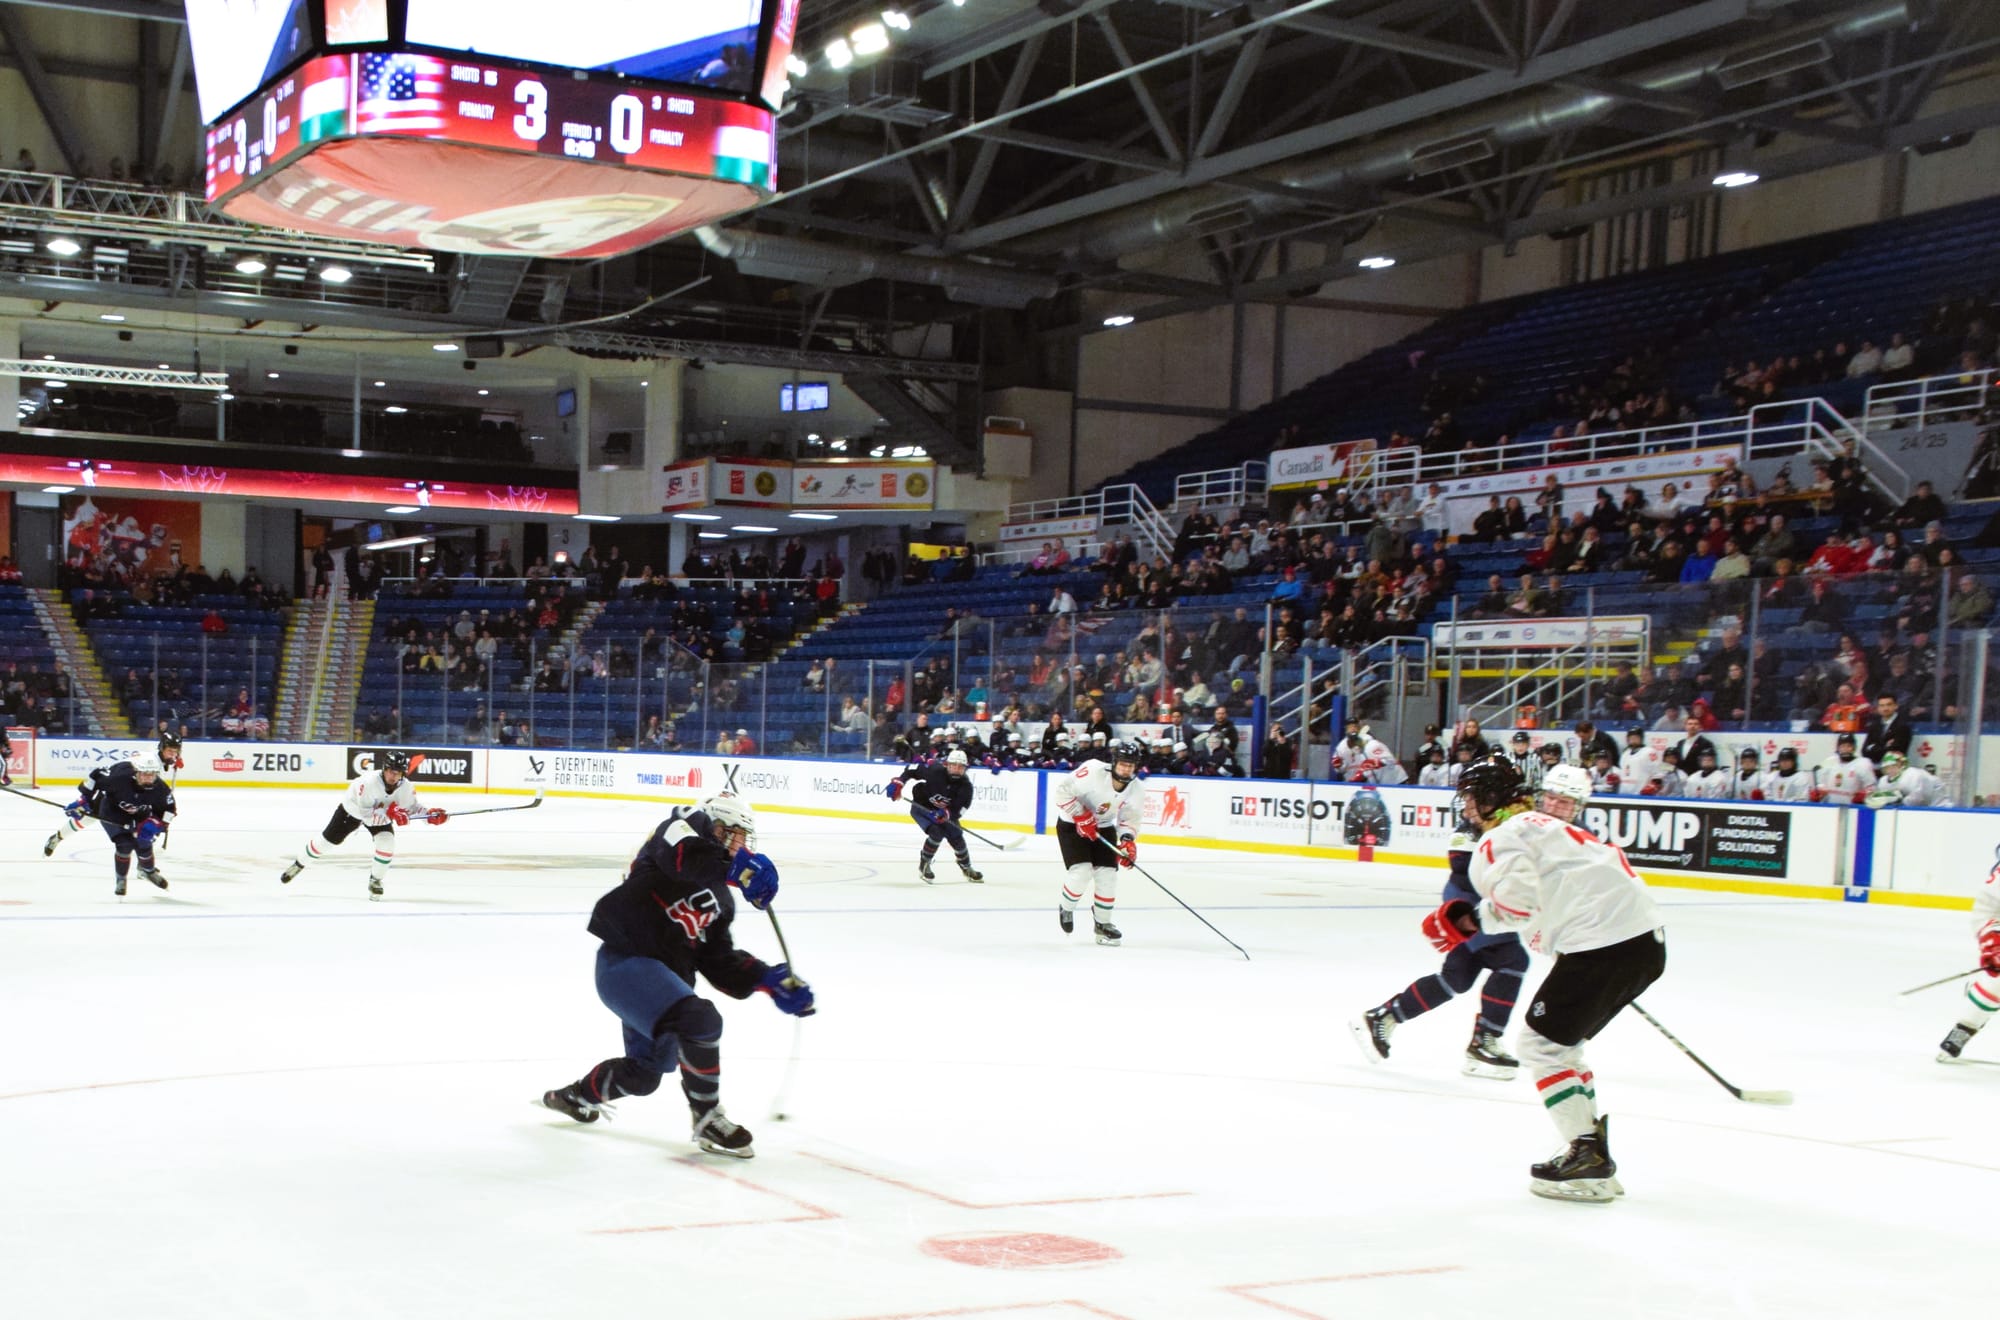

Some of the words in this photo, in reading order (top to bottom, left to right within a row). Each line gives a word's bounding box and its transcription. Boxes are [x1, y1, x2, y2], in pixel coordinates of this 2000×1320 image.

[459, 101, 495, 120] PENALTY
[513, 79, 548, 140] 3
[264, 97, 277, 156] 0
[562, 122, 593, 140] PERIOD
[610, 94, 644, 154] 0
[233, 118, 247, 175] 3
[650, 128, 684, 147] PENALTY
[1278, 454, 1324, 476] Canada
[51, 749, 90, 759] NOVA
[252, 753, 302, 771] ZERO
[433, 758, 467, 776] YOU?
[555, 757, 615, 773] EVERYTHING
[555, 773, 571, 785] FOR
[574, 774, 589, 786] THE
[591, 774, 614, 787] GIRLS
[637, 773, 663, 785] TIMBER
[665, 775, 685, 787] MART
[740, 772, 790, 791] KARBON-X
[1260, 798, 1345, 821] TISSOT
[1585, 807, 1700, 851] BUMP
[1727, 815, 1770, 827] DIGITAL
[1711, 827, 1784, 842] FUNDRAISING
[1479, 837, 1495, 865] 7
[1716, 841, 1777, 855] SOLUTIONS
